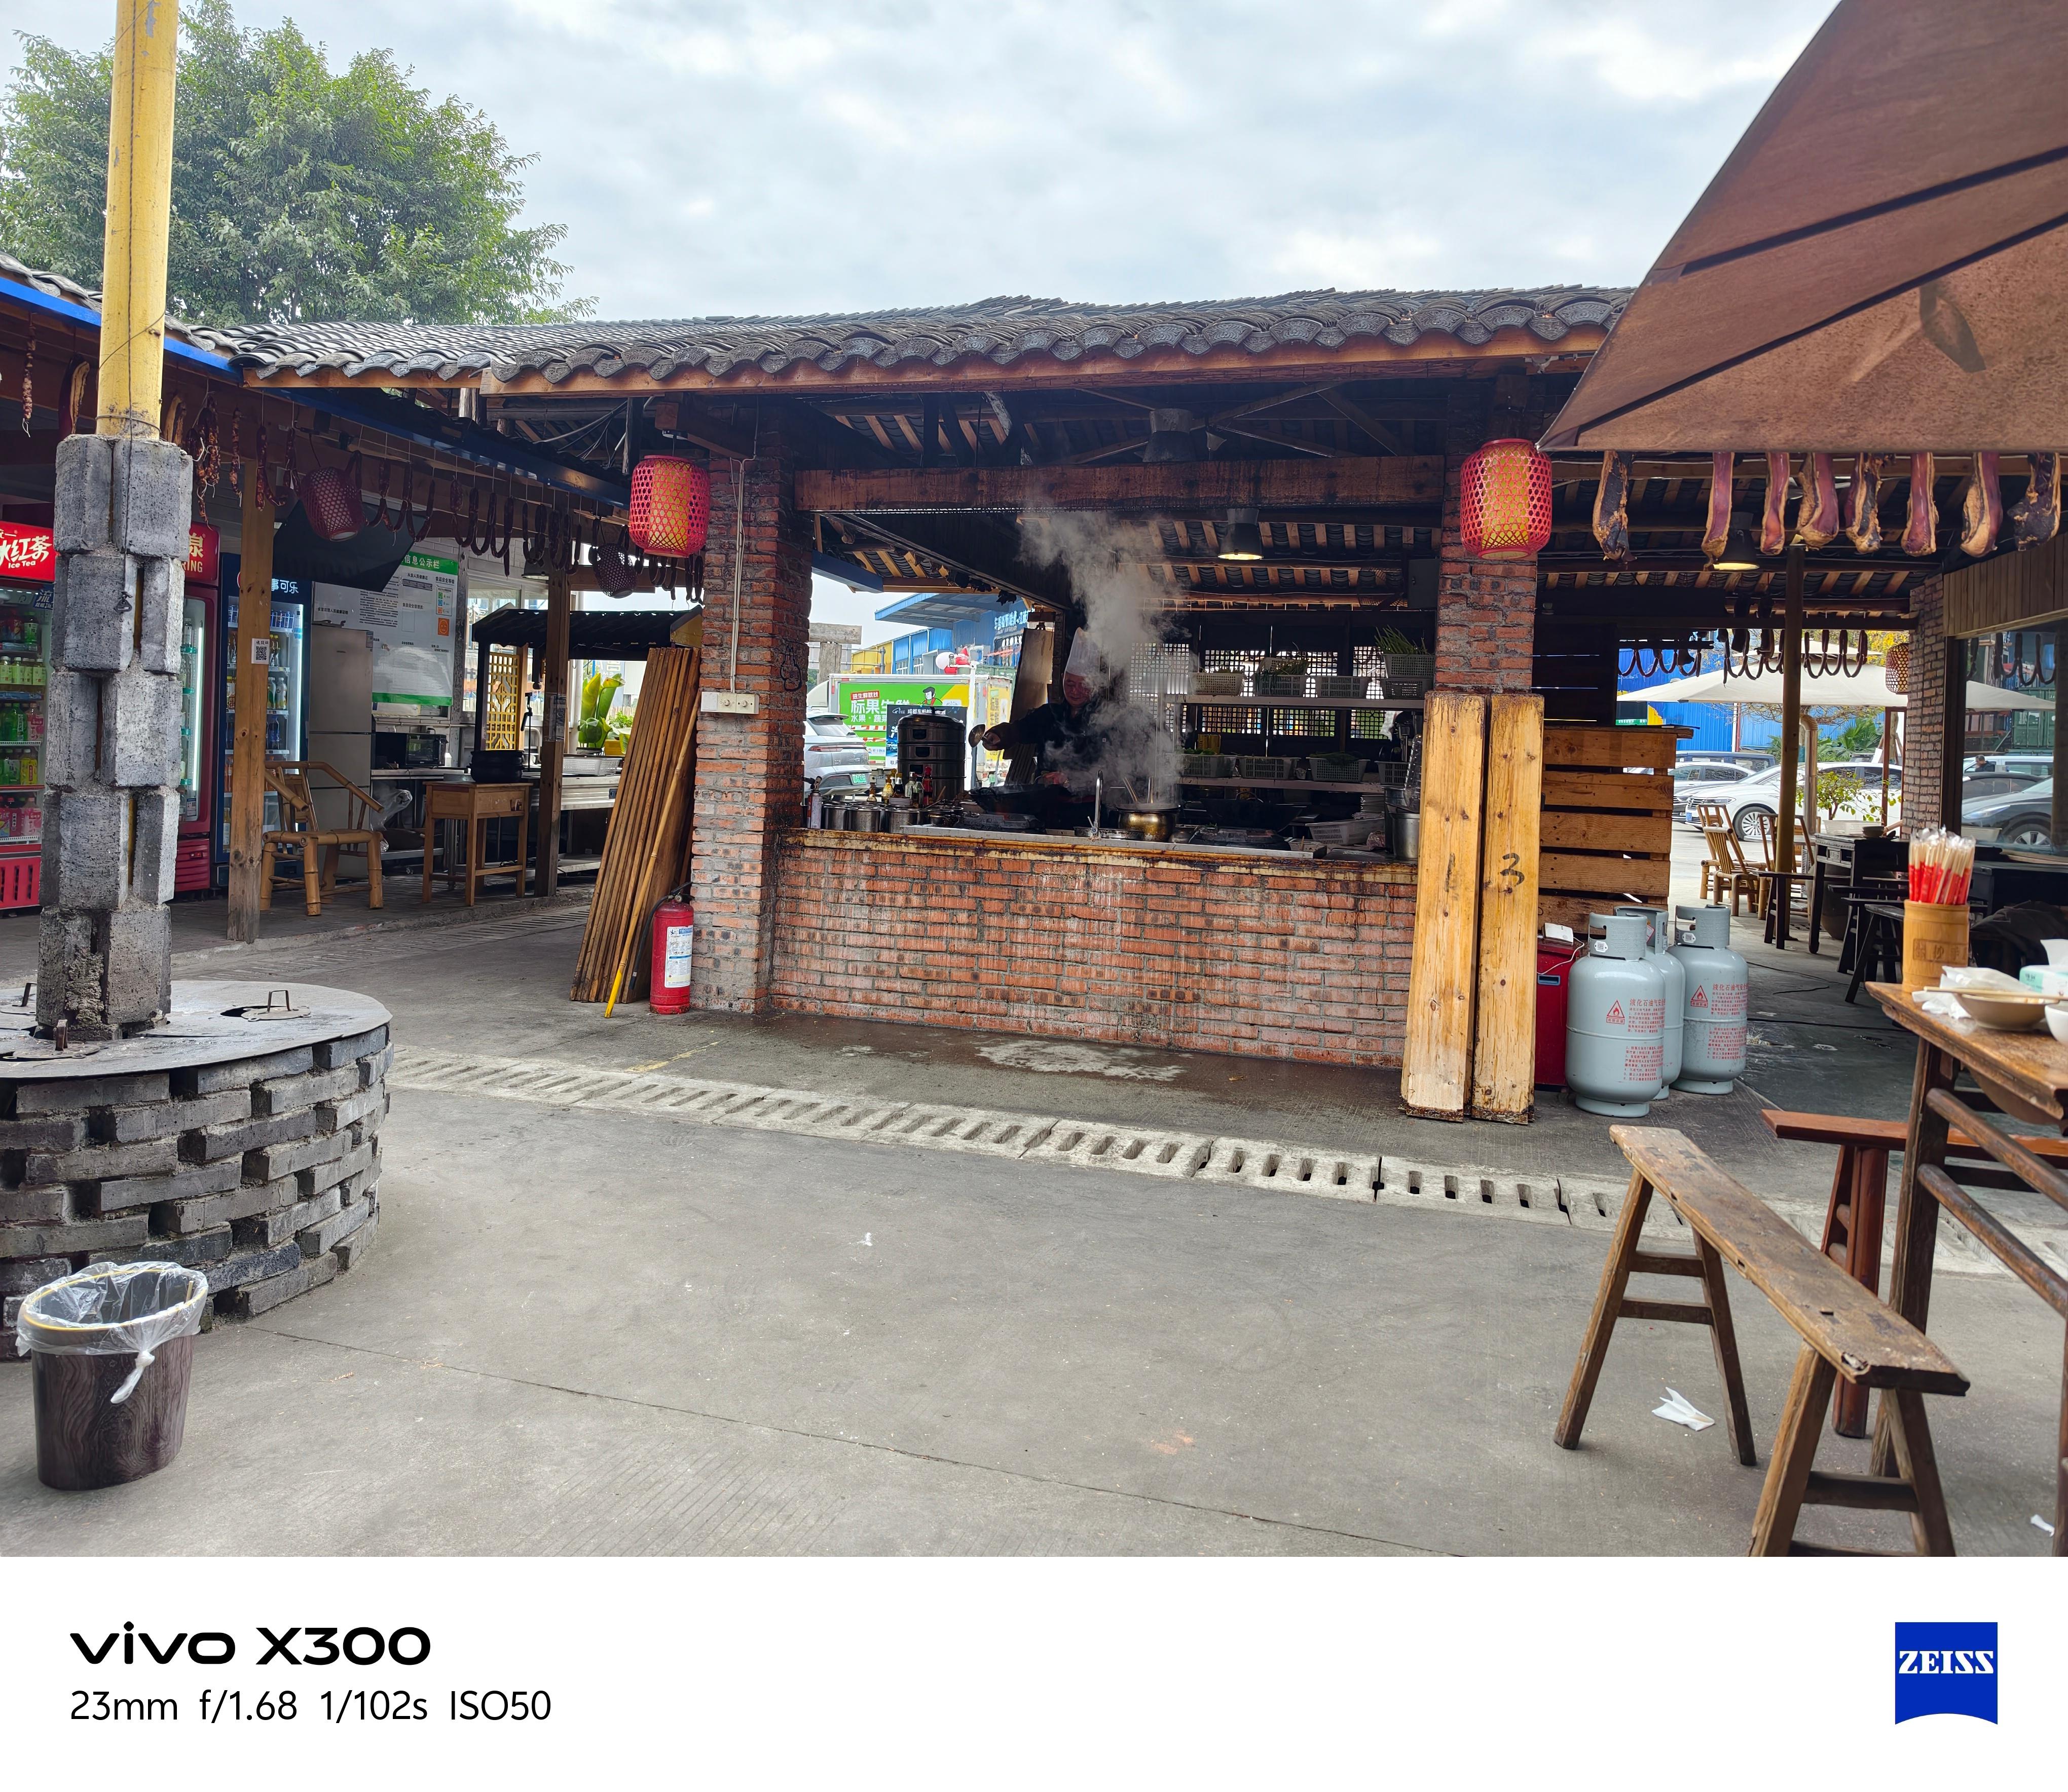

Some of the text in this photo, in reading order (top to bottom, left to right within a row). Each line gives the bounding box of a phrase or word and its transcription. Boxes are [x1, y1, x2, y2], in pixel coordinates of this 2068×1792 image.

[402, 554, 440, 569] 信息公示栏
[1500, 852, 1525, 886] 3
